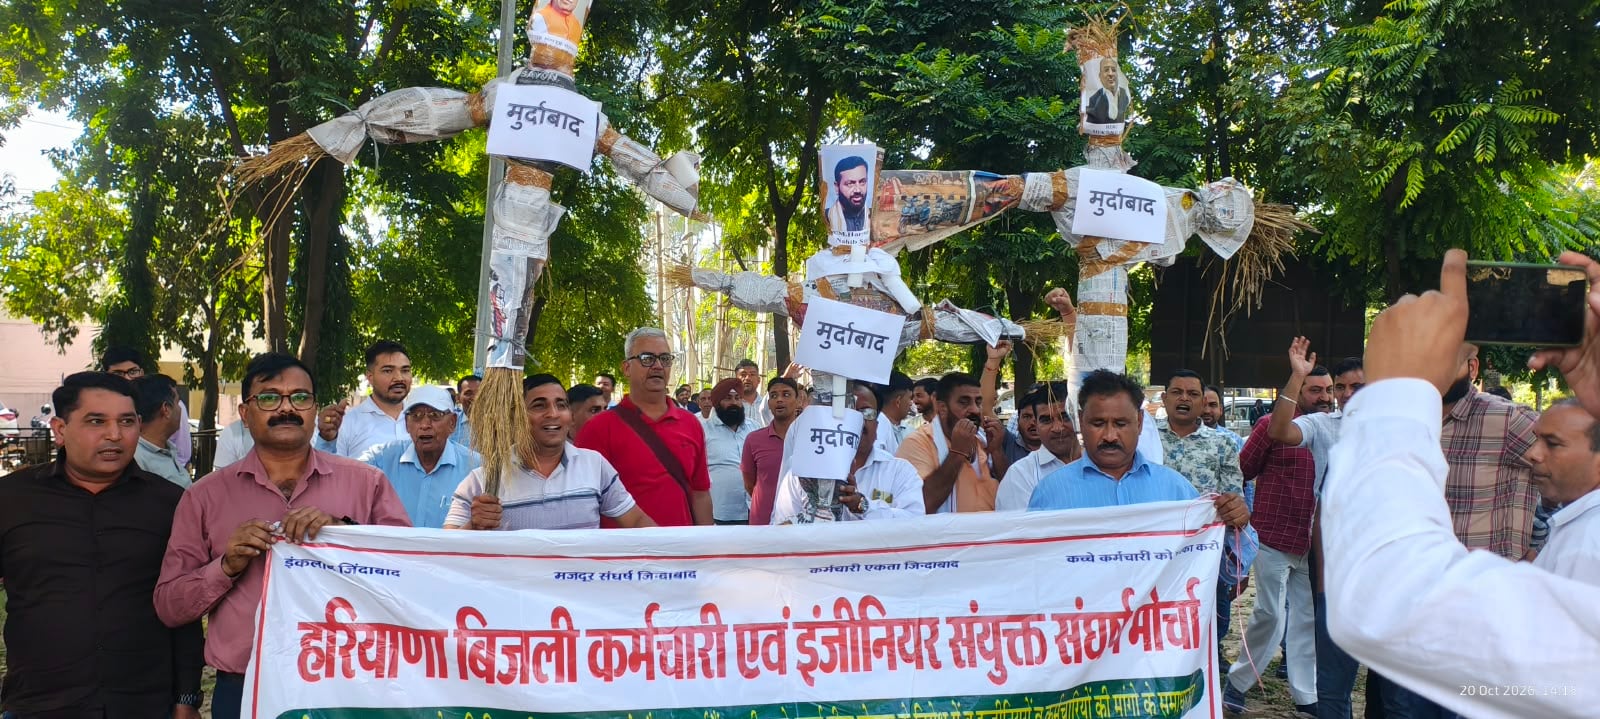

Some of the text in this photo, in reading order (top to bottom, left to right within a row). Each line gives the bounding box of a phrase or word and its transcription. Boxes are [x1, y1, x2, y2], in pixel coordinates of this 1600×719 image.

[506, 101, 585, 138] मुर्दाबाद
[1089, 188, 1156, 217] मुर्दाबाद
[816, 322, 890, 354] मुर्दाबाद
[810, 424, 860, 455] मुर्दाबा
[809, 559, 960, 574] कर्मचारी एकता जिन्दाबाद
[1065, 551, 1095, 564] कच्चे
[1099, 549, 1151, 563] कर्मचारी
[1153, 549, 1173, 561] को
[1195, 540, 1220, 552] करो
[338, 561, 401, 577] जिंदाबाद
[554, 571, 595, 582] मजदूर
[598, 569, 633, 581] संघर्ष
[297, 577, 1201, 687] हरियाणा बिजली कर्मचारी एवं इंजीनियर संयुक्त संघर्ष मोर्चा
[1094, 685, 1111, 718] की
[1112, 681, 1140, 716] मांगो
[1141, 681, 1157, 716] के
